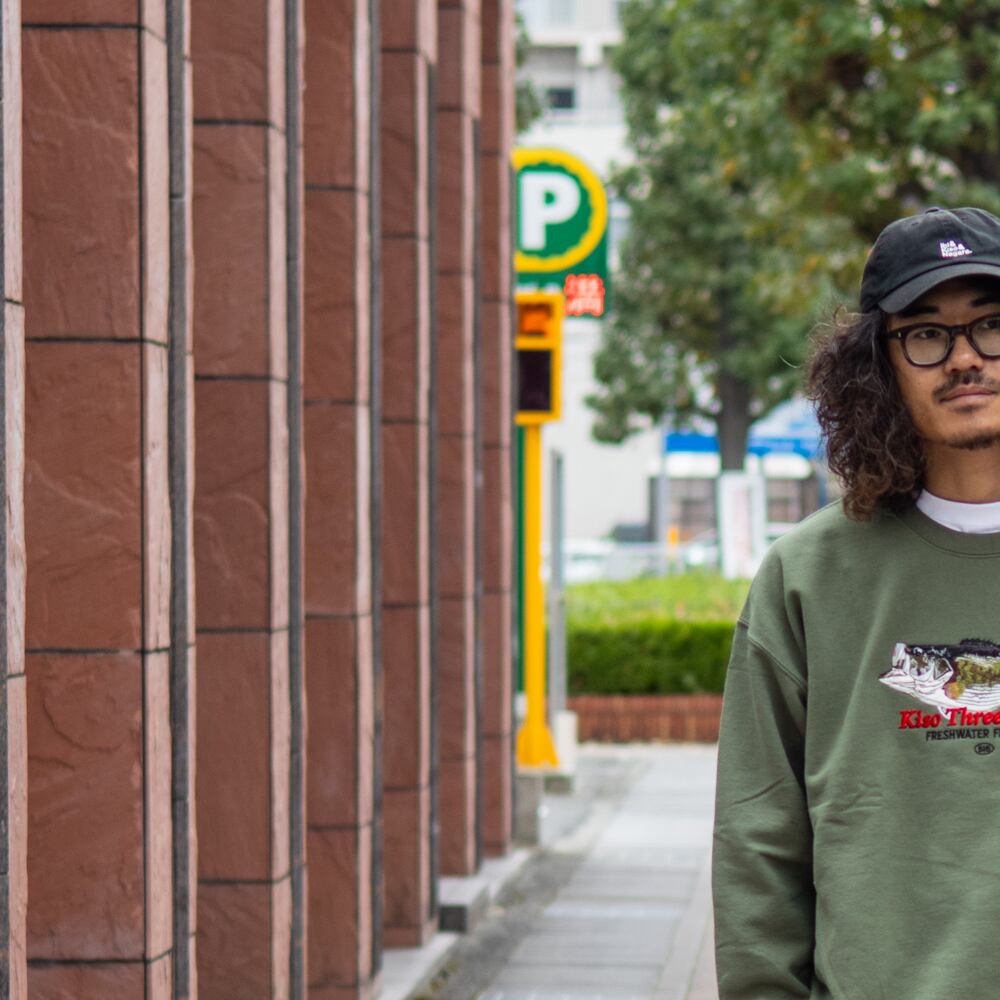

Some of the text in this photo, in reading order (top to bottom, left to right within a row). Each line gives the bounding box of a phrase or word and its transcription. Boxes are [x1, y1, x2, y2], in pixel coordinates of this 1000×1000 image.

[519, 170, 582, 251] P
[899, 709, 941, 730] Kiso
[926, 728, 990, 741] FRESHWATER
